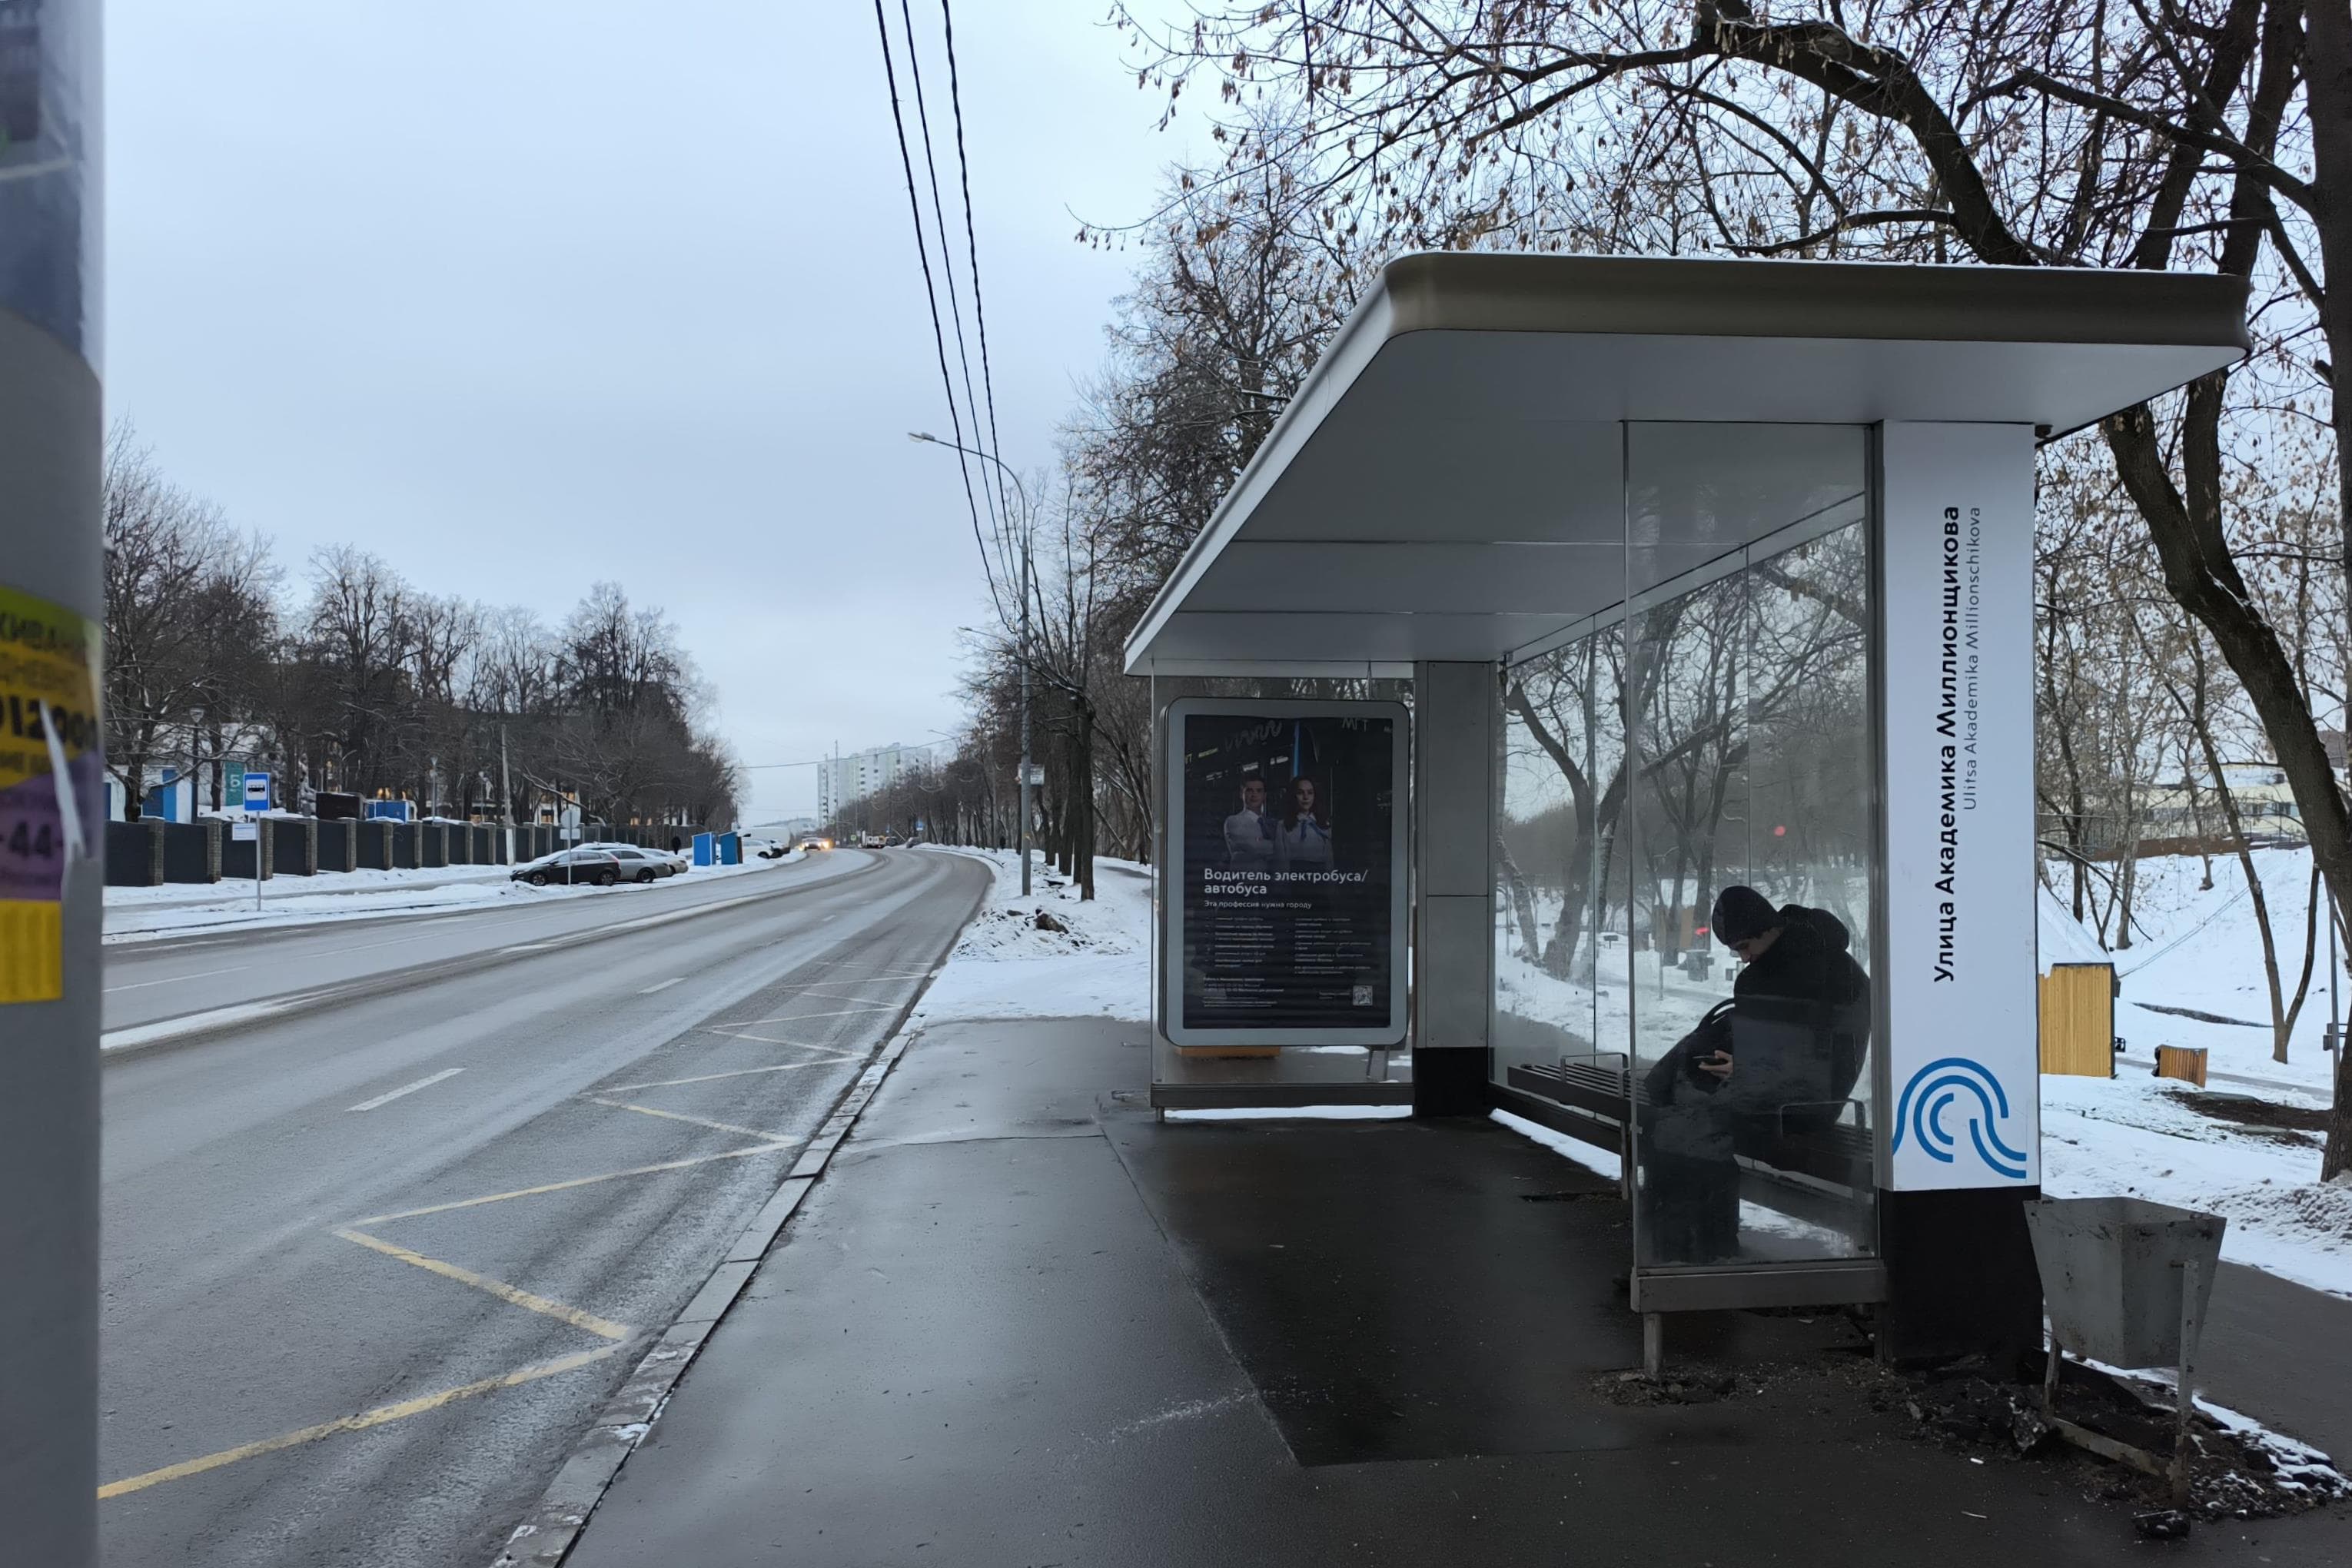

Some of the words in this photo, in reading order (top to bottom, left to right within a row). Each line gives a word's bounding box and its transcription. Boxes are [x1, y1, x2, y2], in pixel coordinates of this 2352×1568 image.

[1965, 507, 1981, 650] Millionschikova
[1936, 507, 1962, 739] Миллионщикова
[1963, 655, 1979, 755] Akademika
[1935, 746, 1958, 895] Академика
[1963, 760, 1978, 810] Ulitsa
[1204, 868, 1271, 882] Водитель
[1274, 869, 1369, 884] электробуса/
[1204, 882, 1267, 897] автобуса
[1218, 900, 1260, 909] профессия
[1286, 902, 1313, 910] городу
[1934, 902, 1958, 983] Улица
